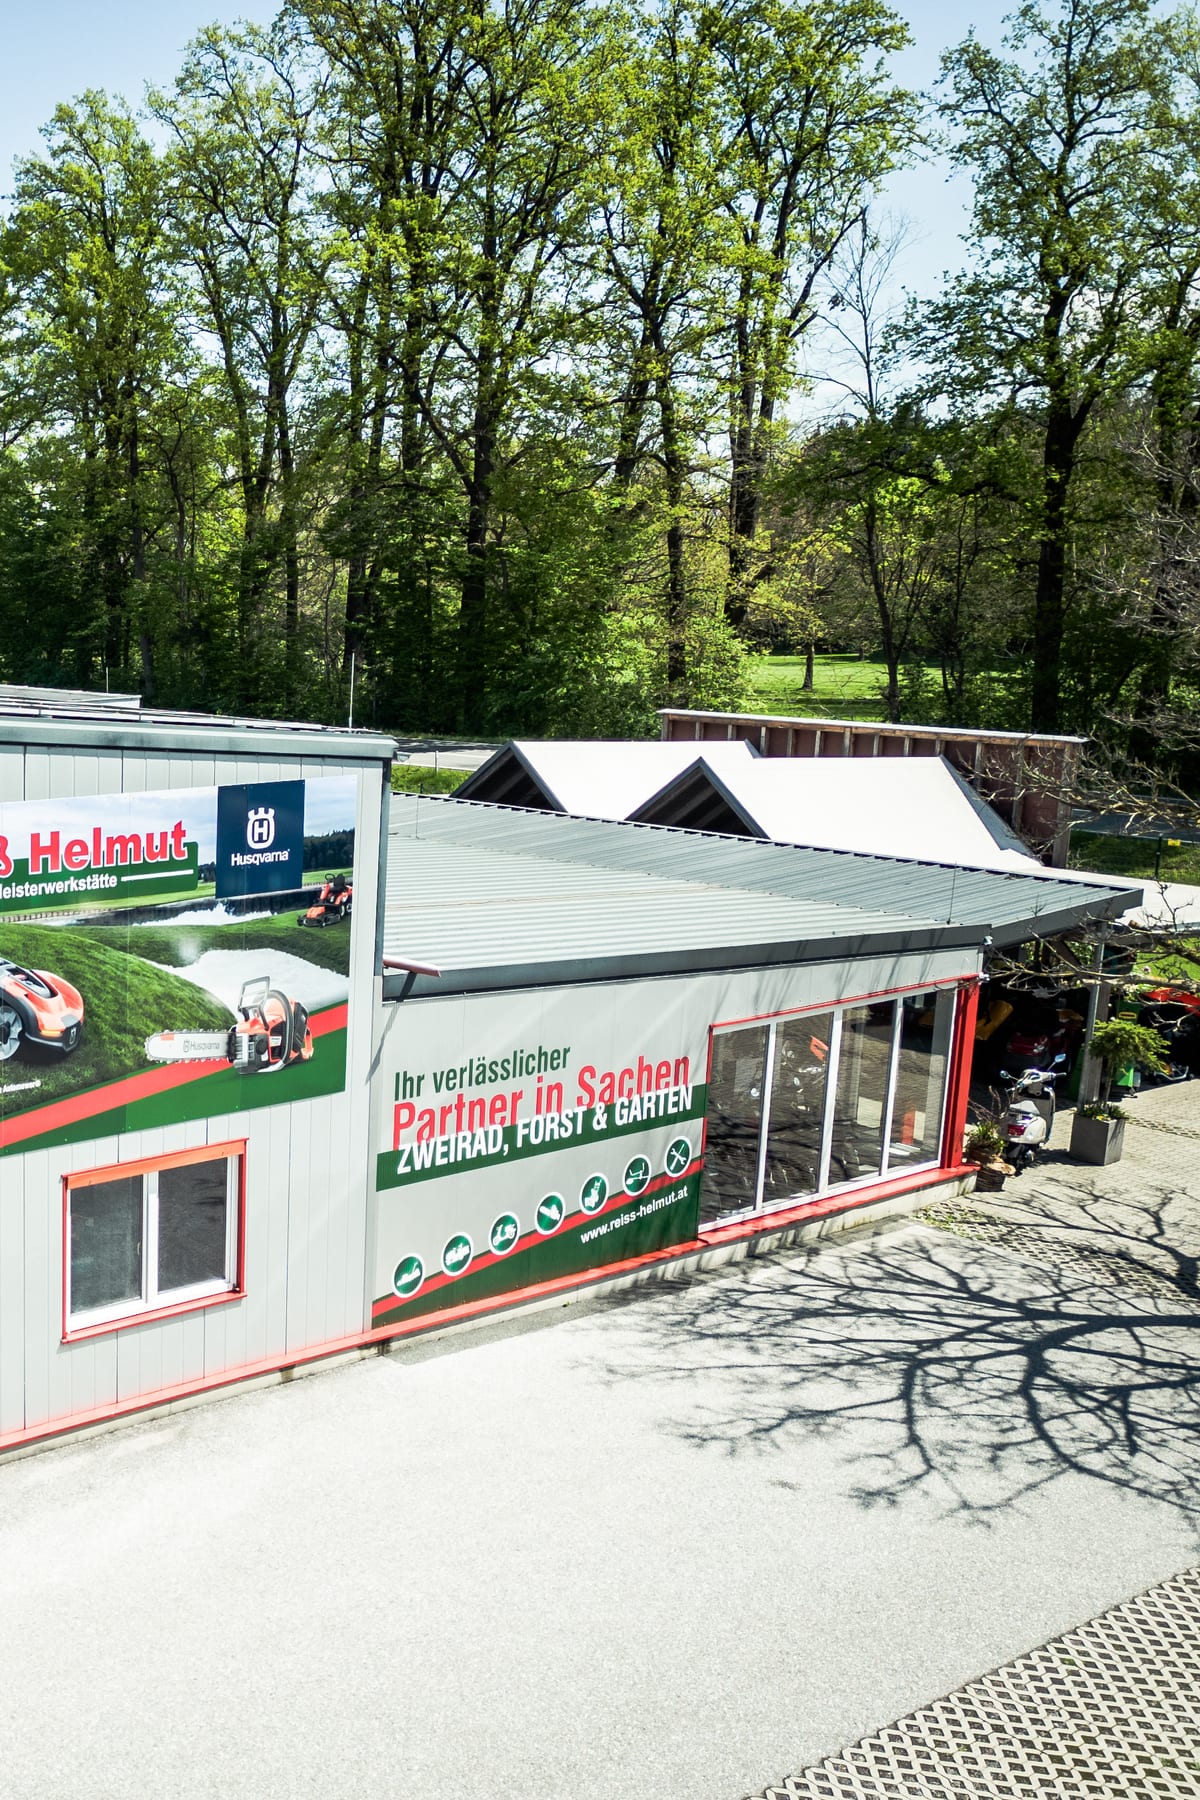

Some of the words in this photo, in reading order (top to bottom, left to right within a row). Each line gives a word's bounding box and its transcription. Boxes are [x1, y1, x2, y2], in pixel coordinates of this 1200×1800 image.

[30, 820, 187, 874] Helmut
[231, 850, 289, 866] Husqvarna
[394, 1071, 425, 1101] Ihr
[432, 1045, 571, 1093] verlässlicher
[393, 1090, 523, 1151] Partner
[536, 1076, 564, 1115] in
[577, 1055, 690, 1110] Sachen
[397, 1124, 509, 1175] ZWEIRAD,
[516, 1106, 588, 1147] FORST
[593, 1105, 608, 1131] &
[615, 1083, 694, 1125] GARTEN
[580, 1185, 689, 1244] www.reiss-helmut.at
